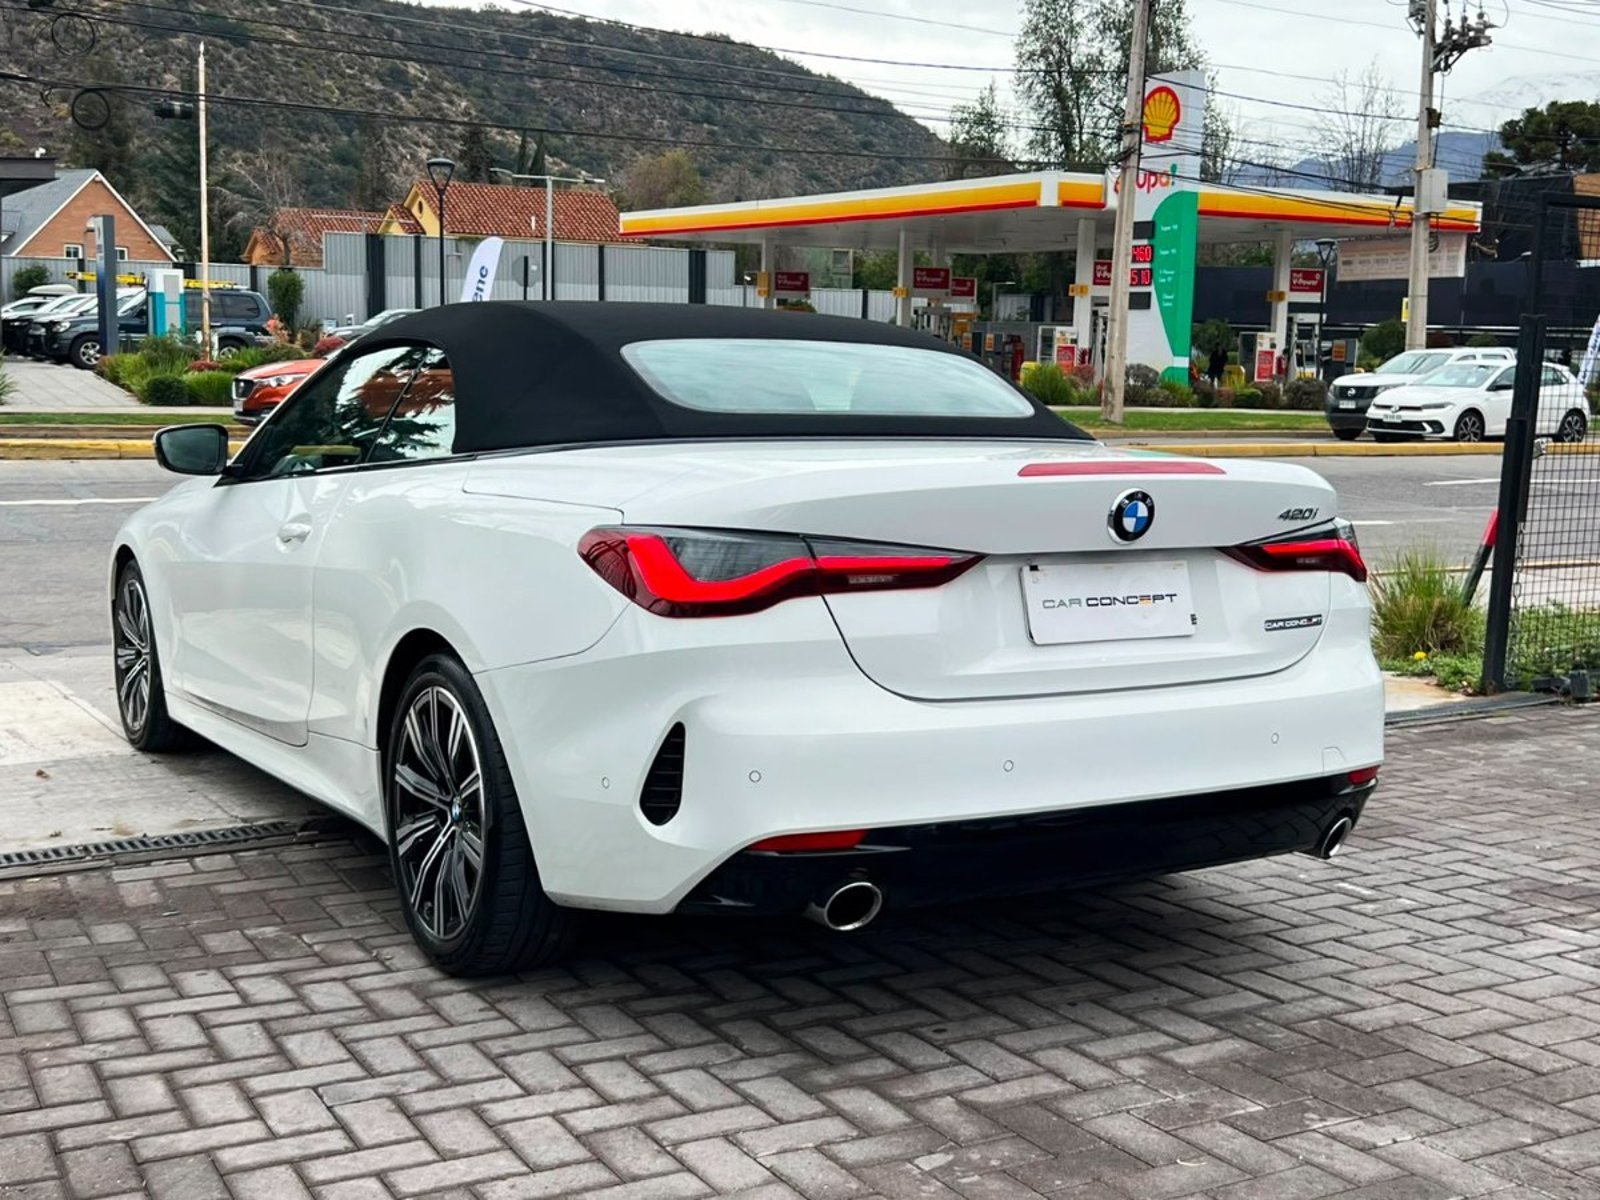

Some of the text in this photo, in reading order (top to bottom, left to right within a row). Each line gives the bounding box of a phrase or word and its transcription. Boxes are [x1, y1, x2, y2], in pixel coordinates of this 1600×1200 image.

[1278, 507, 1319, 521] 420i
[1042, 594, 1178, 609] CAR CONCEPT
